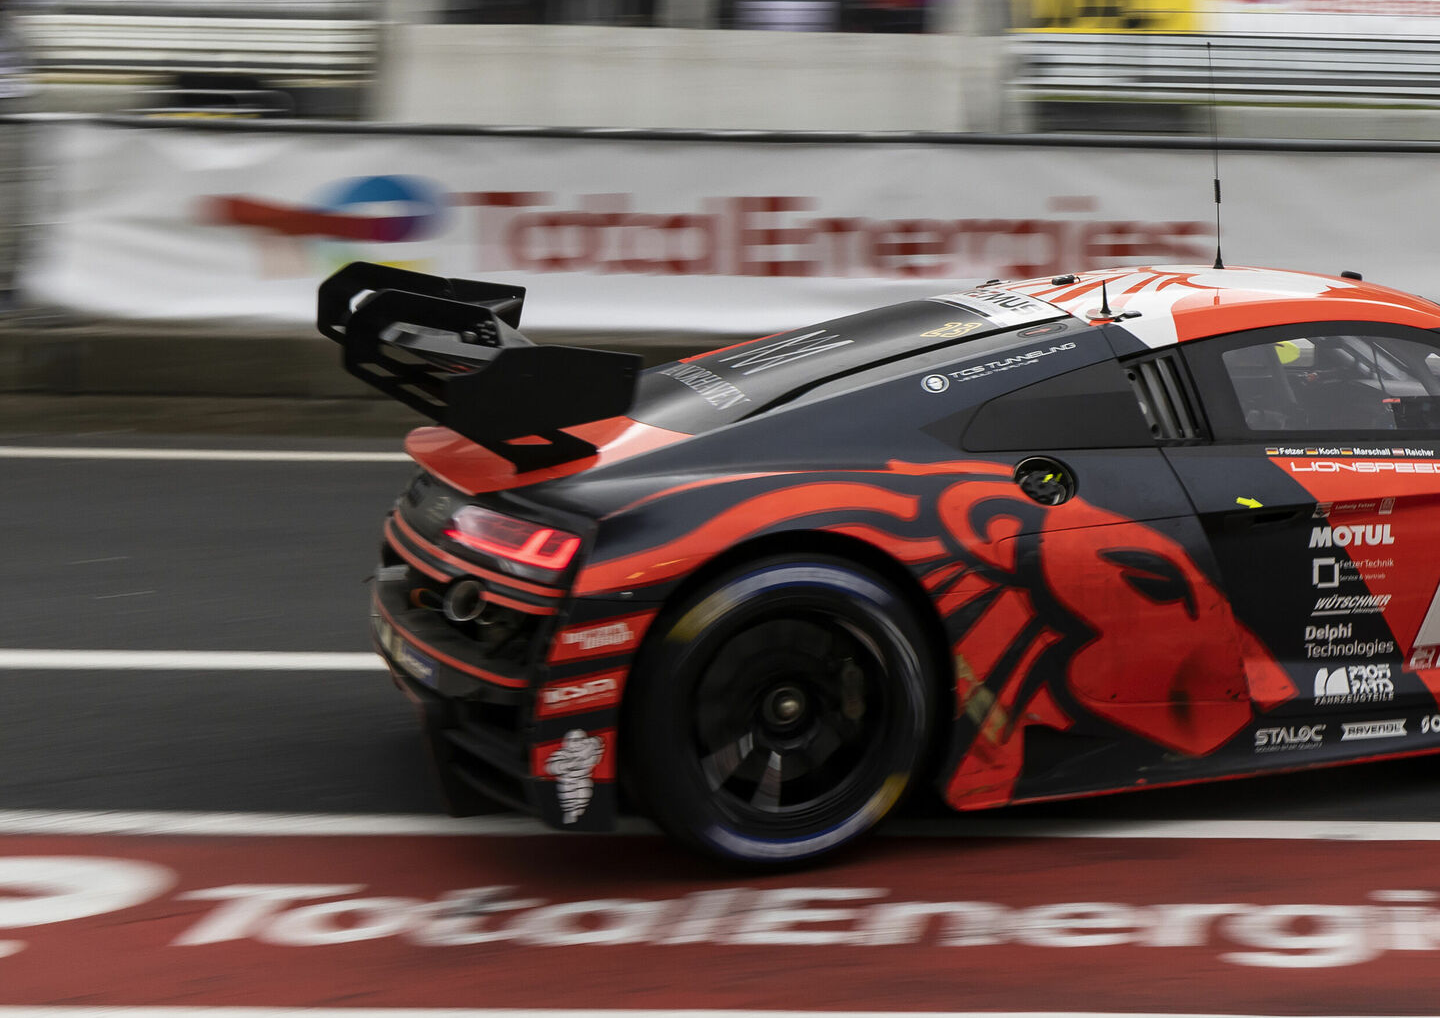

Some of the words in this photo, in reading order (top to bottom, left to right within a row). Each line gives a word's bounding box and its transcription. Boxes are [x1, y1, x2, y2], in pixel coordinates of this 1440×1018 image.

[452, 188, 1226, 280] TotalEnergies
[948, 363, 986, 380] TCS
[984, 341, 1077, 370] TUNNELING
[1278, 447, 1305, 456] Fetzer
[1318, 447, 1341, 456] Koch
[1353, 447, 1391, 457] Marschall
[1405, 448, 1435, 457] Reicher
[1308, 523, 1395, 549] MOTUL
[1364, 557, 1394, 568] Technik
[1313, 593, 1393, 611] WÜTSCHNER
[1304, 622, 1353, 643] Delphi
[1305, 638, 1394, 659] Technologies
[1348, 663, 1392, 679] PROFI
